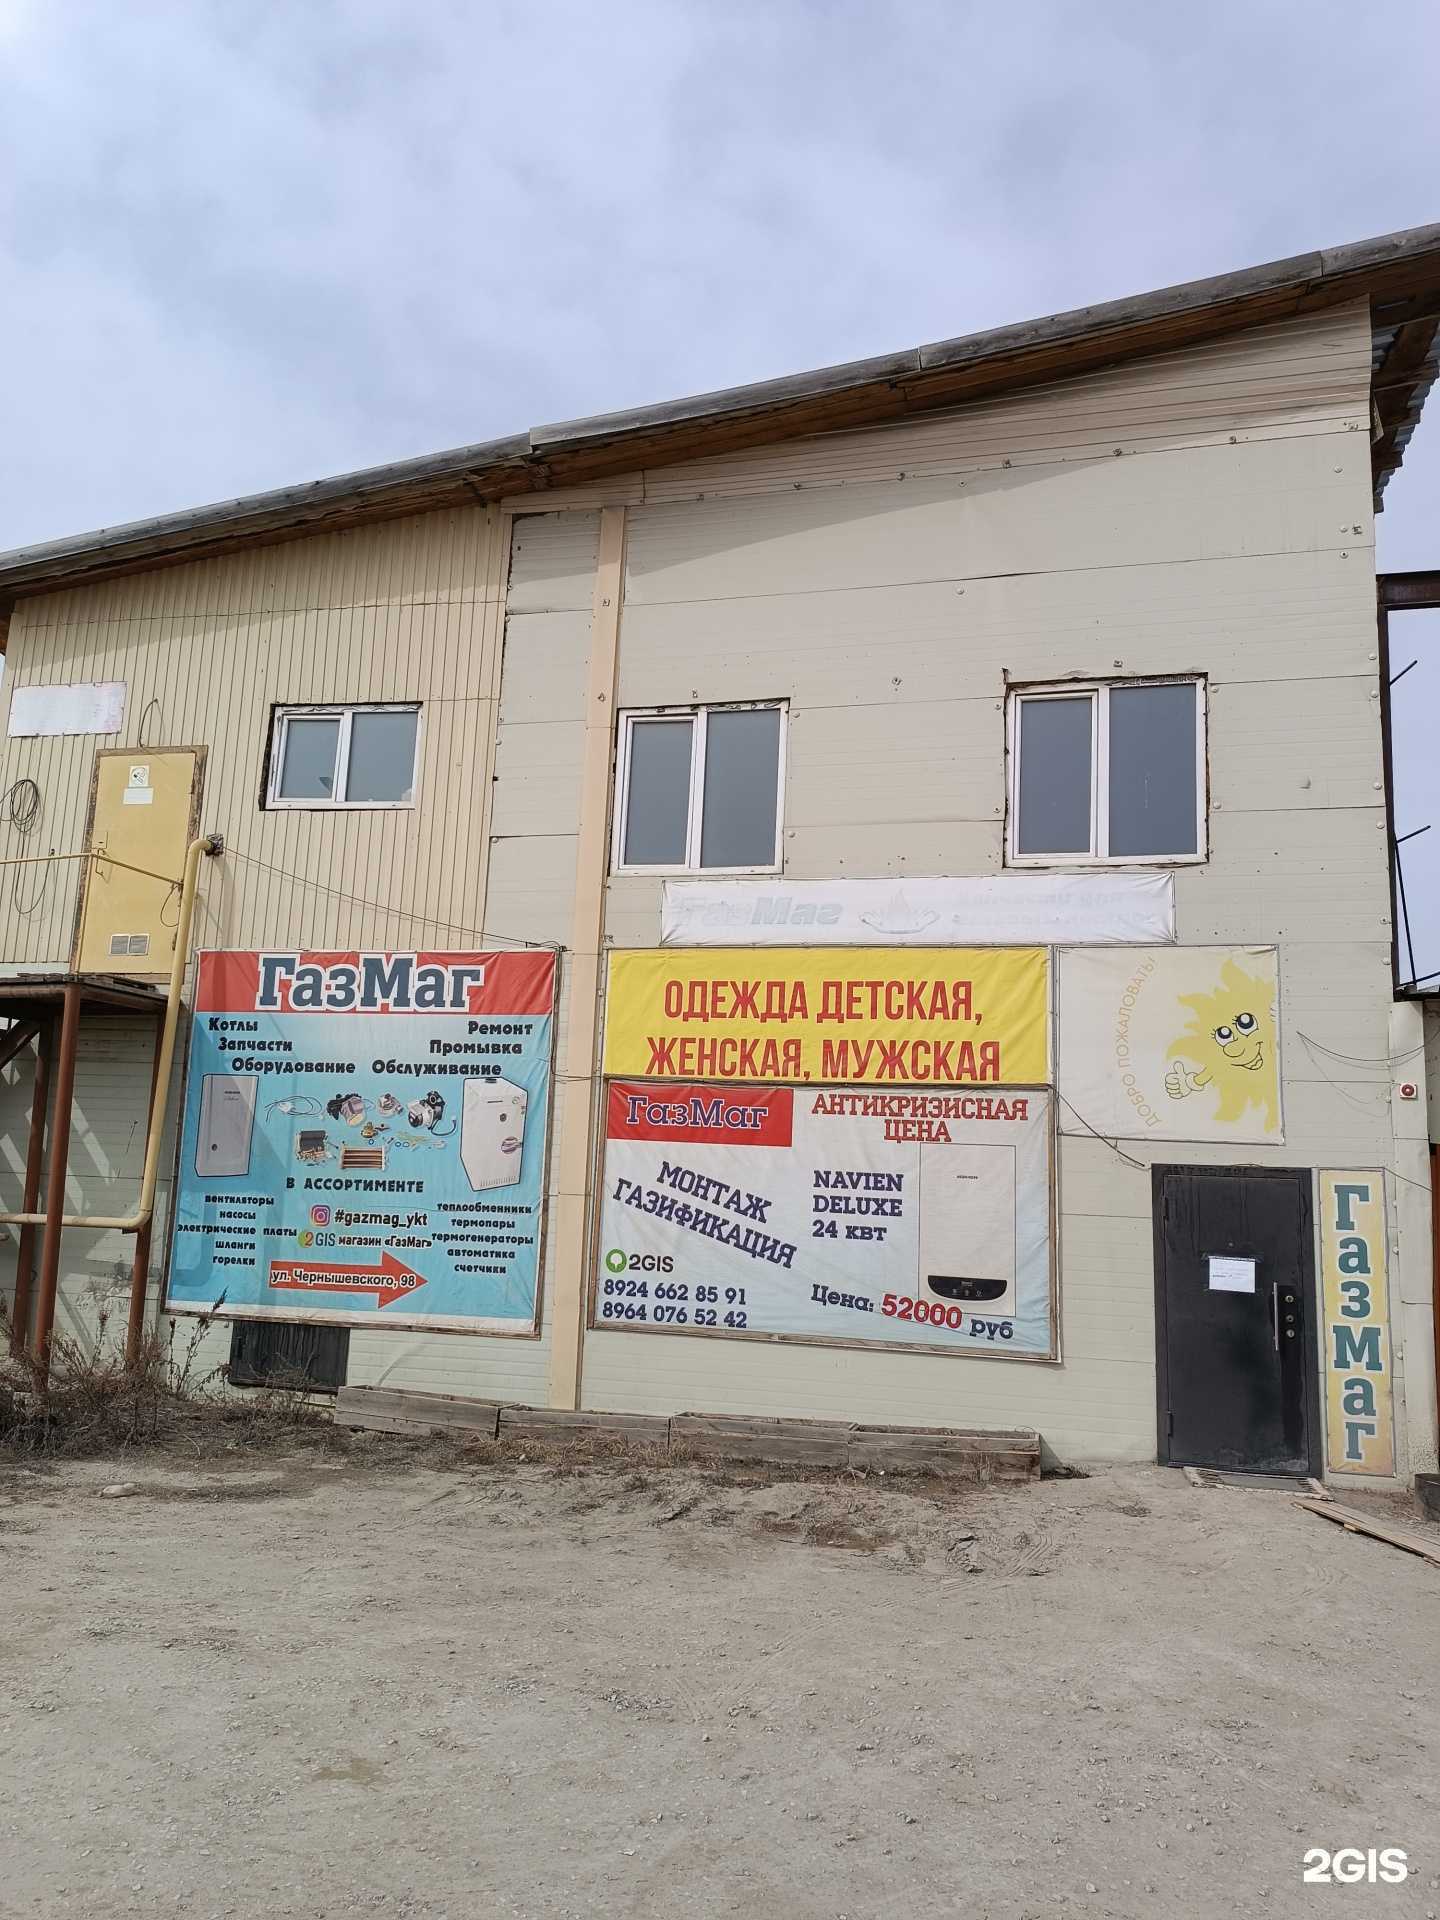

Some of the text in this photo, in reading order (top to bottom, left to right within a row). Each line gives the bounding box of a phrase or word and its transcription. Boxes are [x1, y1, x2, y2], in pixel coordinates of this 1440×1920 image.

[255, 953, 485, 1011] ГазМаг
[664, 980, 983, 1025] ОДЕЖДА ДЕТСКАЯ,
[208, 1017, 258, 1031] Котлы
[468, 1020, 533, 1035] Ремонт
[218, 1036, 292, 1051] Запчасти
[429, 1039, 522, 1056] Промывка
[231, 1056, 356, 1074] Оборудование
[371, 1059, 502, 1077] Обслуживание
[645, 1037, 1000, 1082] ЖЕНСКАЯ, МУЖСКАЯ
[811, 1093, 1029, 1122] АНТИКРИЗИСНАЯ
[1122, 1073, 1162, 1127] ДОБРО
[626, 1096, 769, 1130] ГазМаг
[884, 1119, 952, 1144] ЦЕНА
[286, 1177, 424, 1193] В АССОРТИМЕНТЕ
[813, 1170, 904, 1192] NAVIEN
[204, 1194, 275, 1206] вентиляторы
[656, 1161, 772, 1224] МОНТАЖ
[219, 1210, 256, 1219] насосы
[437, 1202, 532, 1213] теплообменники
[812, 1195, 903, 1217] DELUXE
[334, 1209, 428, 1228] #gazmag_ykt
[451, 1218, 515, 1229] термопары
[612, 1178, 798, 1269] ГАЗИФИКАЦИЯ
[177, 1224, 297, 1236] электрические платы
[812, 1219, 838, 1238] 24
[215, 1241, 256, 1250] шланги
[338, 1236, 381, 1246] магазин
[384, 1236, 432, 1248] «ГазМаг»
[431, 1233, 534, 1245] термогенераторы
[212, 1255, 256, 1266] горелки
[447, 1248, 515, 1259] автоматика
[454, 1264, 507, 1274] счетчики
[628, 1254, 674, 1273] 2GIS
[271, 1269, 415, 1288] ул. Чернышевского, 98
[603, 1278, 746, 1305] 8924 662 85 91
[602, 1301, 747, 1329] 8964 076 52 42
[811, 1283, 1014, 1341] Цена: 52000 руб
[1331, 1183, 1384, 1463] ГазМаг
